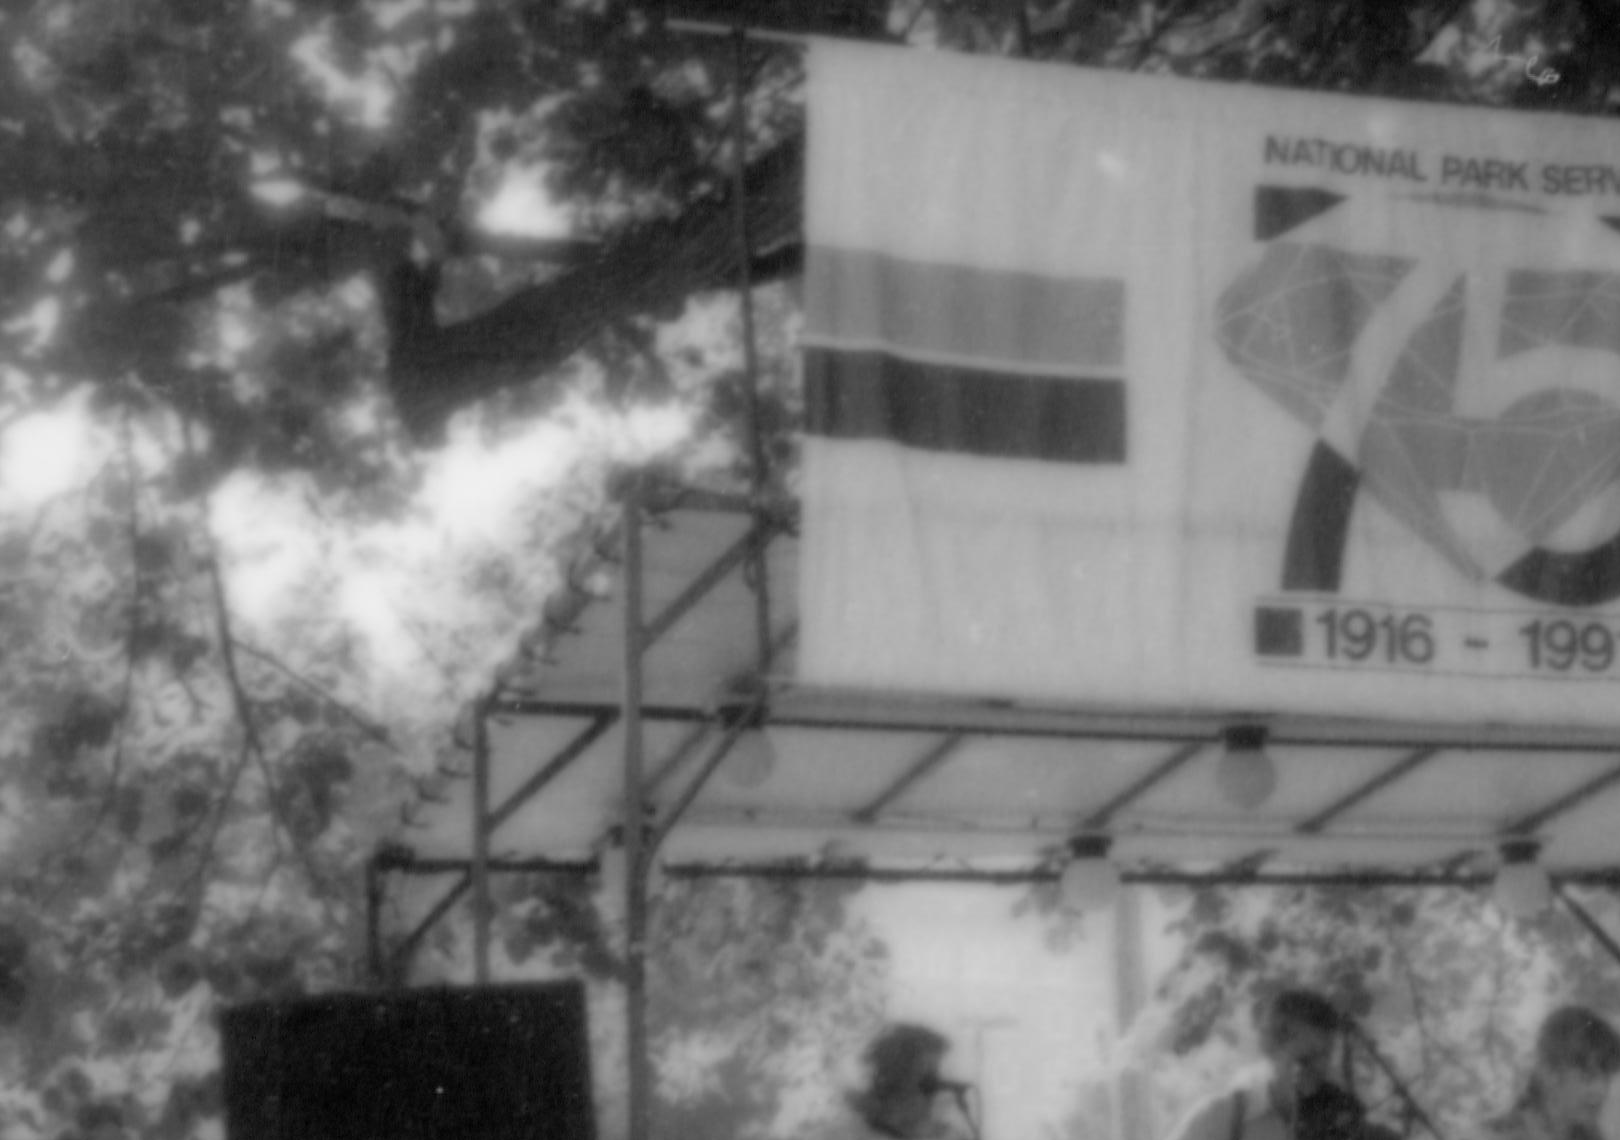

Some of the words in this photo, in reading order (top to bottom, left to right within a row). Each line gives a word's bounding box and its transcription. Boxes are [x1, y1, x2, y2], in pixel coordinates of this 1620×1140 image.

[1263, 135, 1427, 183] NATIONAL
[1440, 155, 1530, 191] PARK
[1315, 608, 1436, 664] 1916
